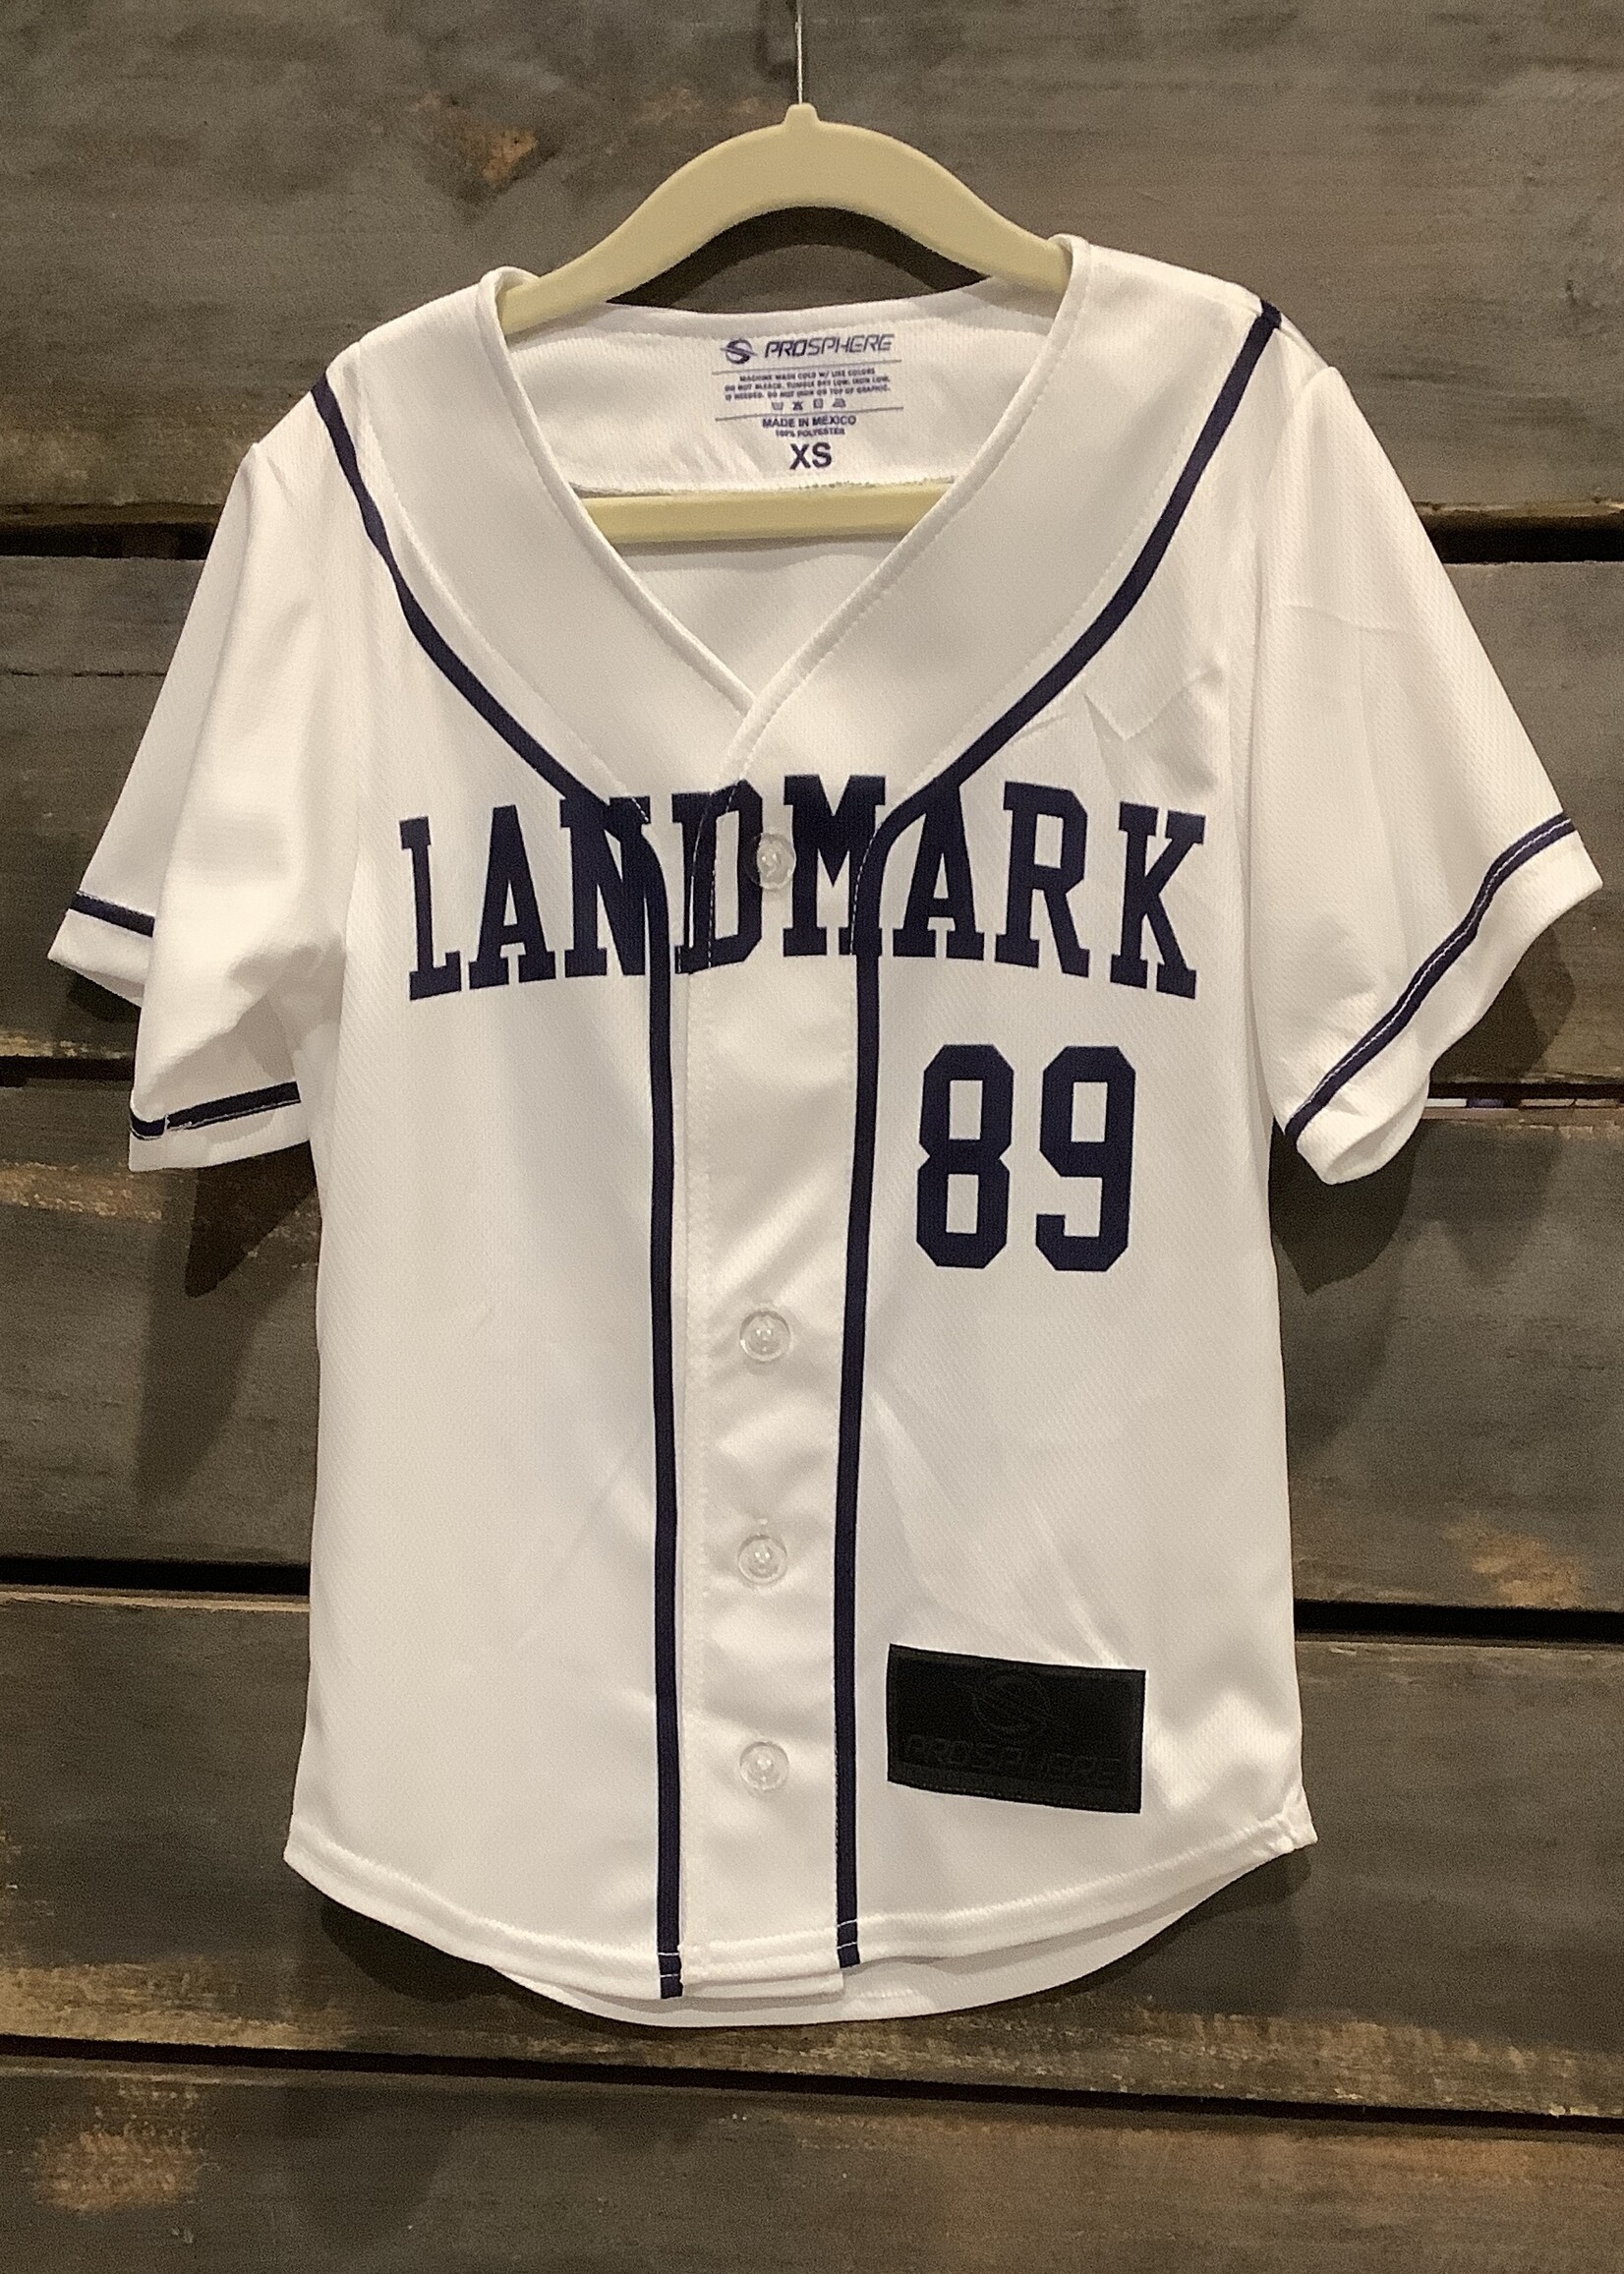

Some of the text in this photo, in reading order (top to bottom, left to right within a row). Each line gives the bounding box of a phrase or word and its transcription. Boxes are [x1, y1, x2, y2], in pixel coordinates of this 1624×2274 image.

[765, 334, 896, 359] PROSPHERE
[847, 368, 875, 377] COLORS
[762, 414, 857, 429] MADE IN MEXICO
[775, 427, 845, 437] 100% POLYESTER
[789, 441, 833, 471] XS
[399, 774, 1206, 1001] LANDMARK
[915, 1043, 1137, 1273] 89
[901, 1733, 1122, 1787] PROSPHERE
